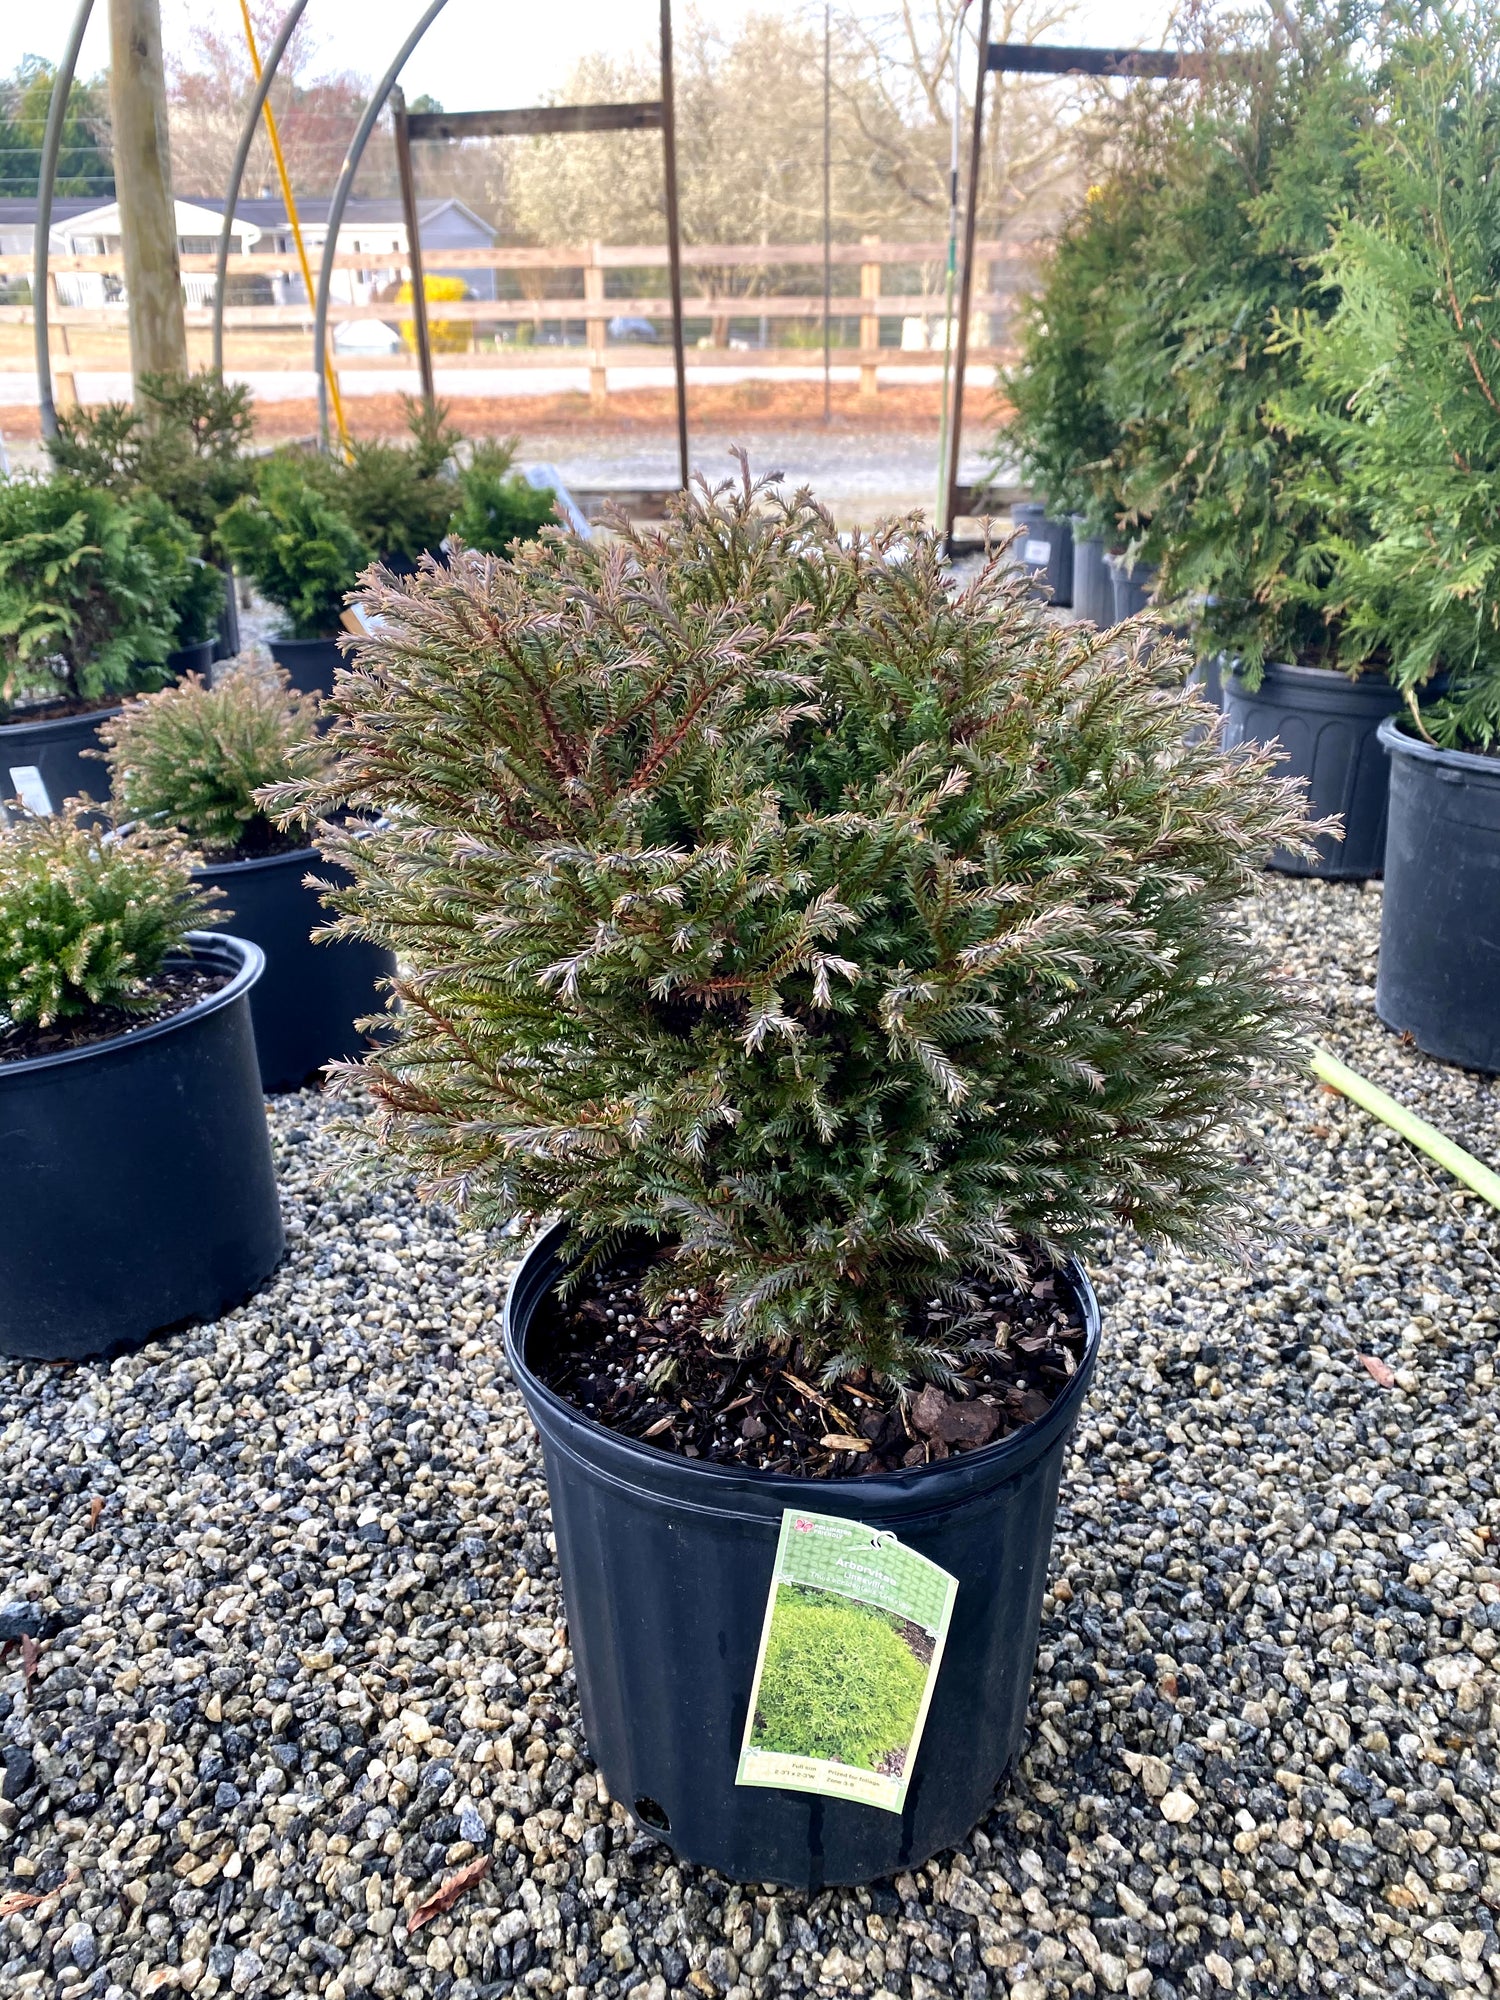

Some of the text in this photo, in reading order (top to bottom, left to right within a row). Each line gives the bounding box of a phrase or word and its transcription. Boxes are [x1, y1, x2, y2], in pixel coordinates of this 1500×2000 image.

[813, 1530, 844, 1539] FRIENDLY
[814, 1524, 852, 1536] POLLINATOR
[836, 1558, 897, 1586] Arborvitae
[843, 1572, 885, 1591] Linesville
[826, 1777, 842, 1785] Zone
[828, 1769, 848, 1778] Prized
[858, 1777, 880, 1787] foliage
